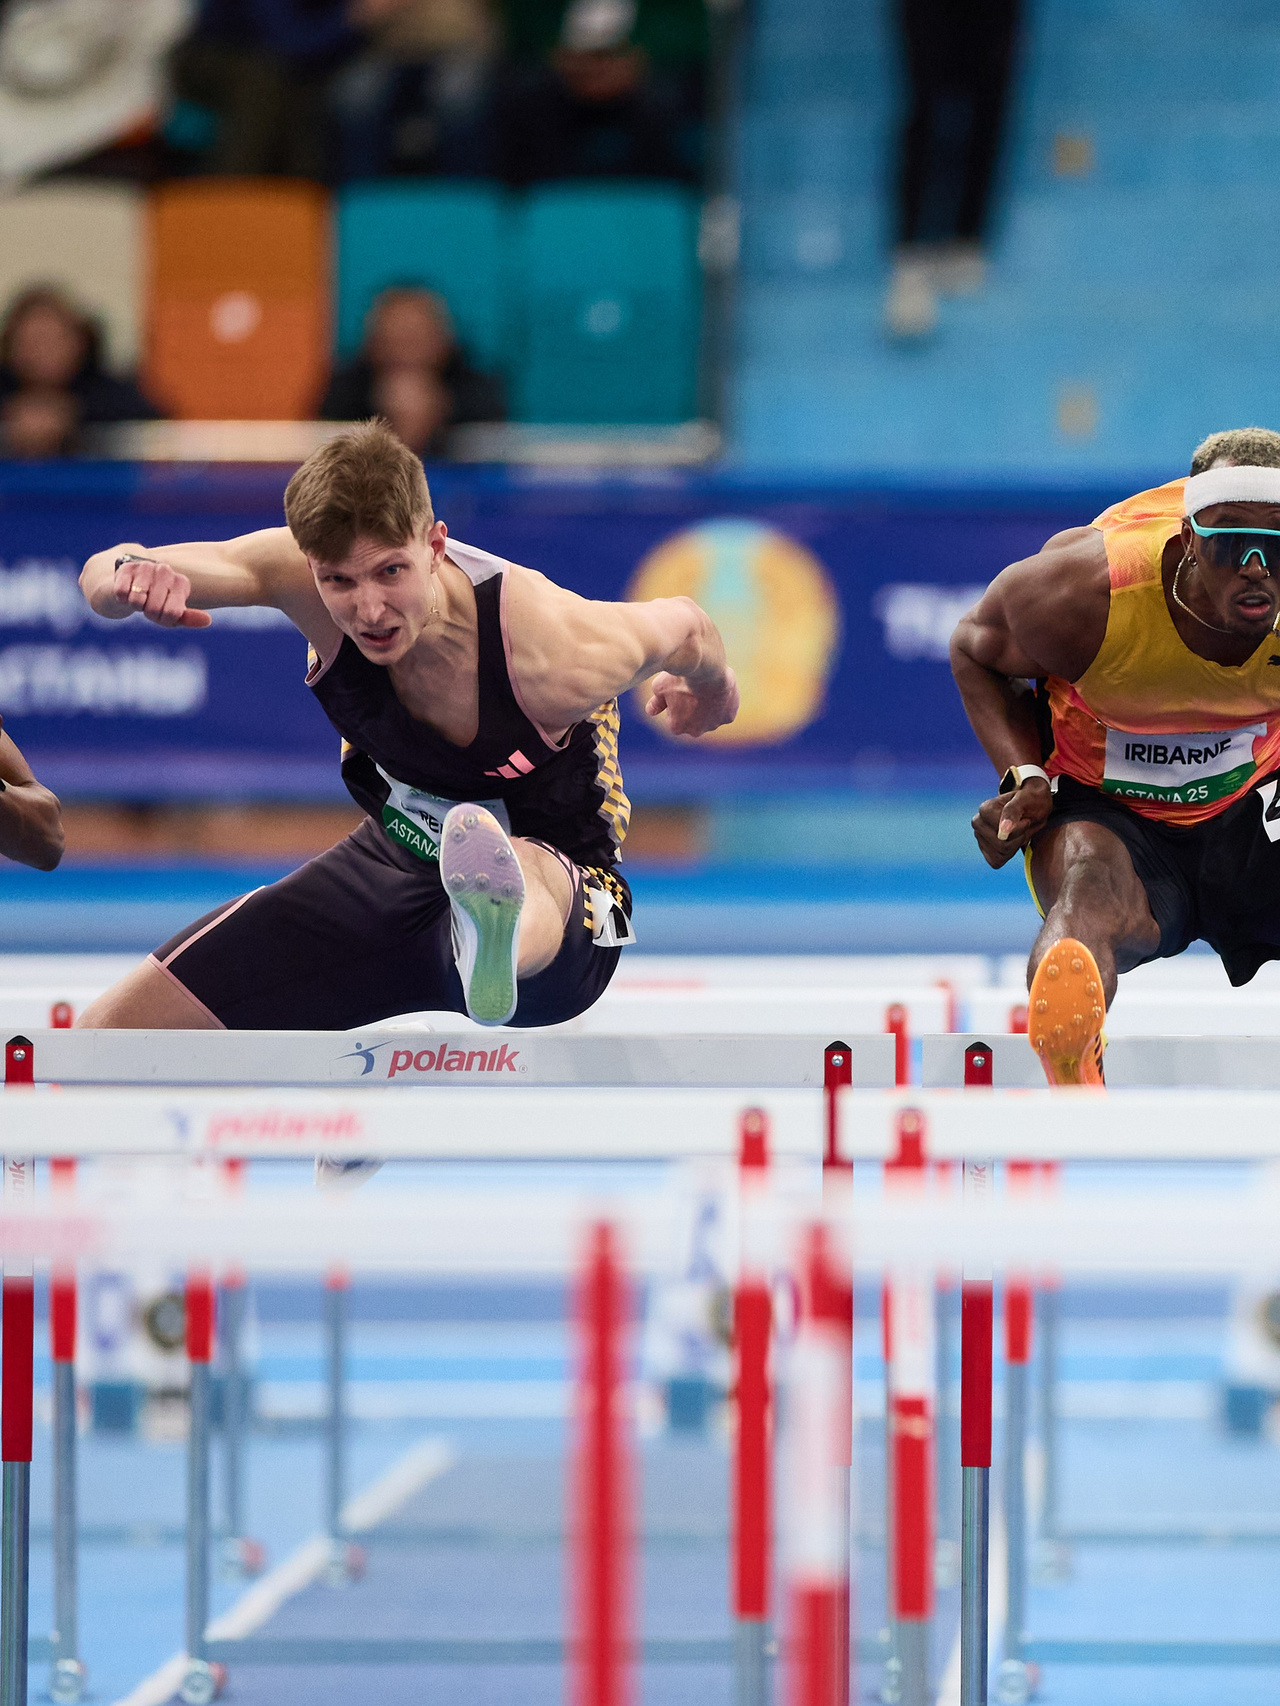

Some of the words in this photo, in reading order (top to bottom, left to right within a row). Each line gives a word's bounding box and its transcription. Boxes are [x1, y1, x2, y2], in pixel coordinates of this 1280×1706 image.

[1124, 738, 1232, 765] IRIBARNE
[1187, 785, 1208, 803] 25
[386, 818, 440, 861] ASTANA
[387, 1042, 520, 1079] polanik
